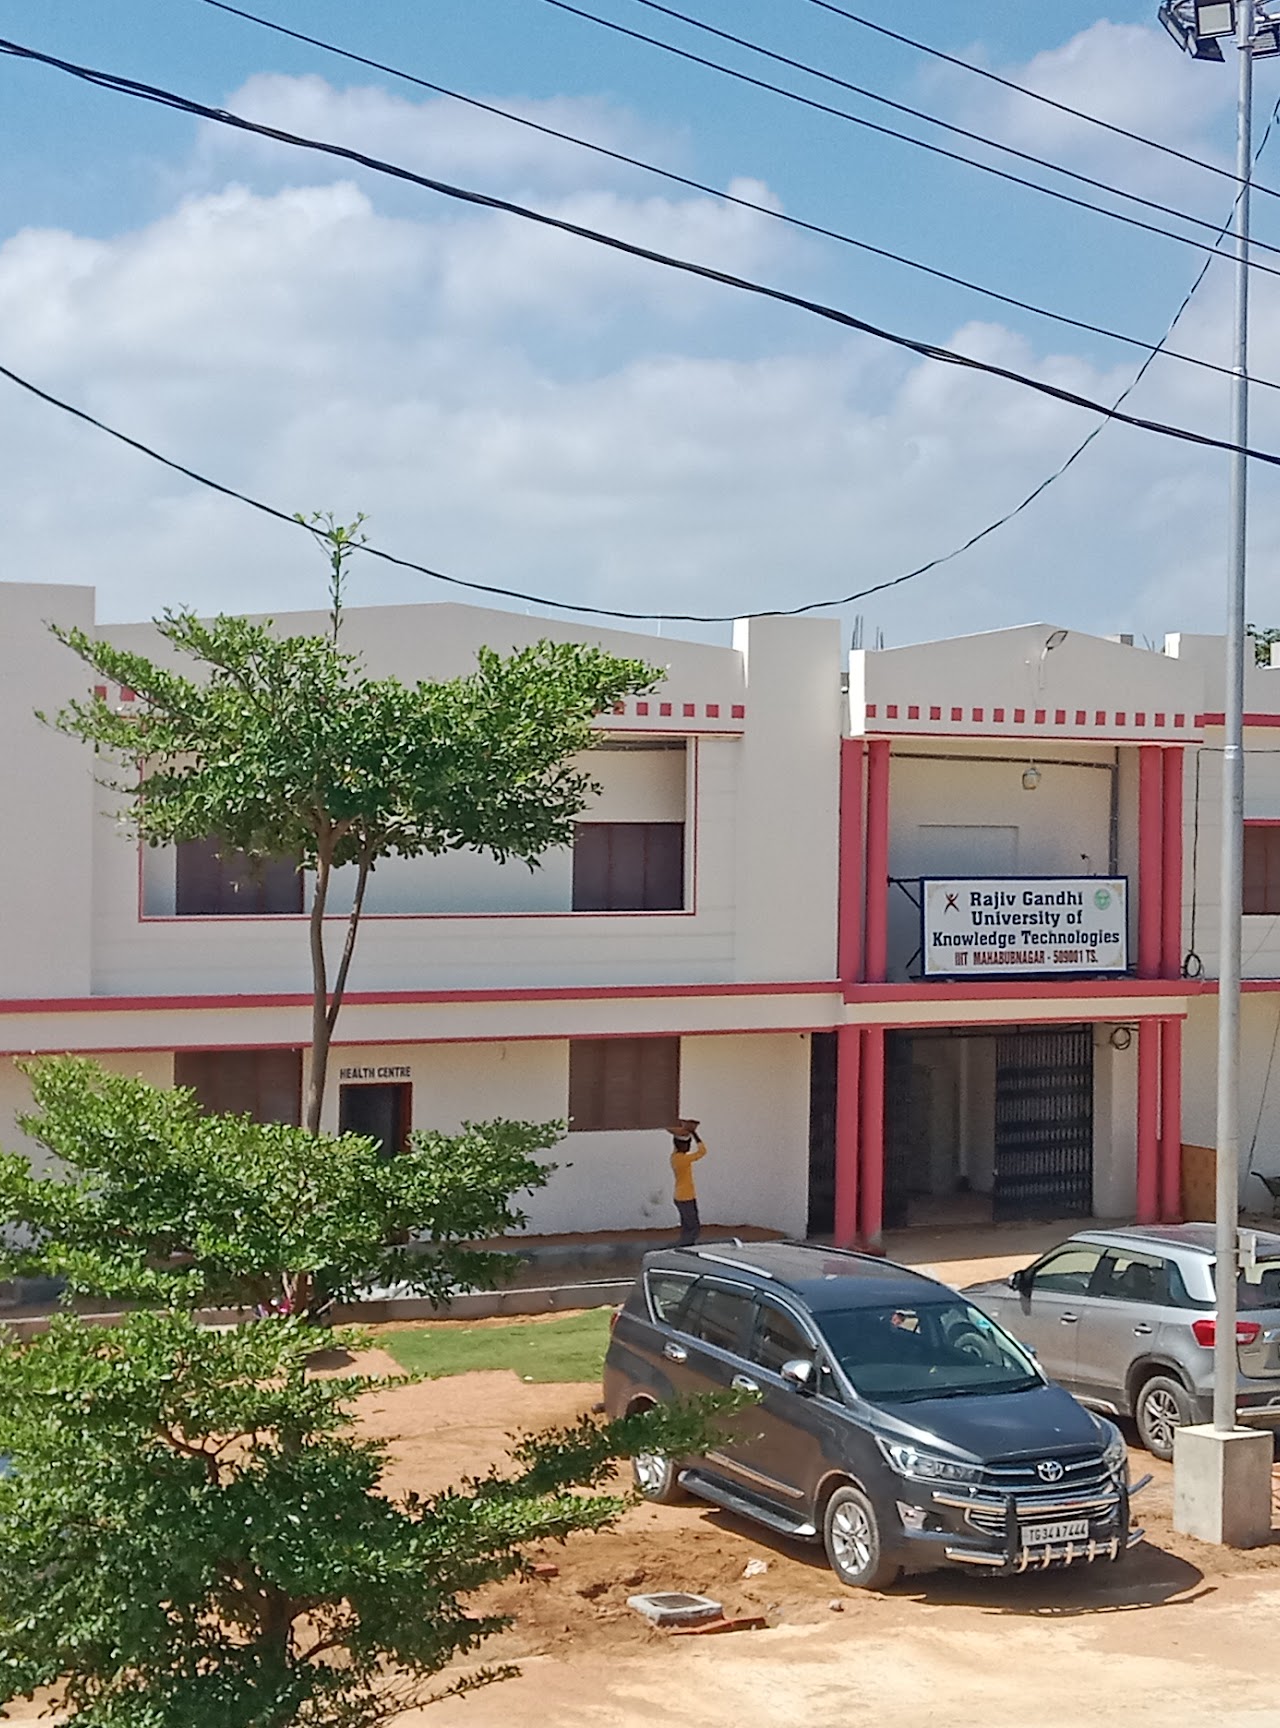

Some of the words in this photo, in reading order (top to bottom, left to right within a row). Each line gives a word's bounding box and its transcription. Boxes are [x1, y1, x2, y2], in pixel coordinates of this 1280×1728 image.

[970, 892, 1016, 909] Rajiv
[1022, 891, 1083, 906] Gandhi
[971, 911, 1061, 927] University
[1066, 909, 1082, 924] of
[933, 930, 1016, 948] Knowledge
[1021, 930, 1120, 946] Technologies
[973, 951, 1045, 965] MAHABUBNAGAR
[1053, 950, 1083, 963] 509001
[340, 1067, 375, 1079] HEALTH
[377, 1066, 411, 1078] CENTRE
